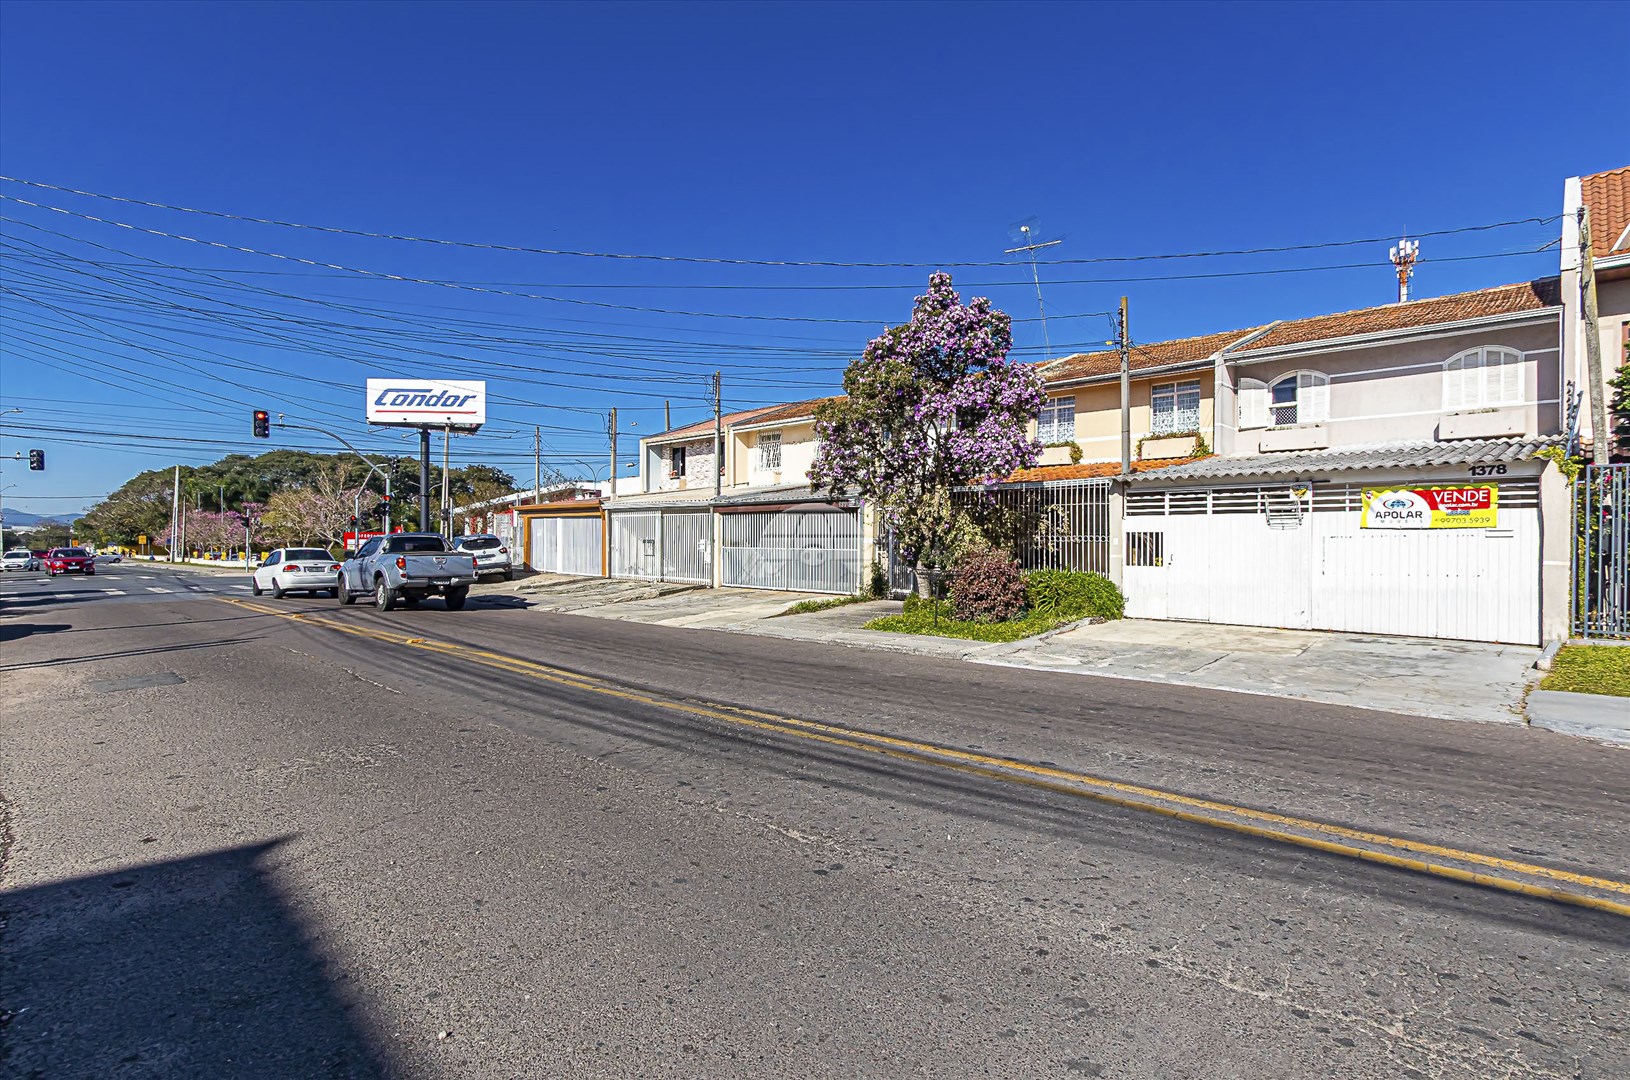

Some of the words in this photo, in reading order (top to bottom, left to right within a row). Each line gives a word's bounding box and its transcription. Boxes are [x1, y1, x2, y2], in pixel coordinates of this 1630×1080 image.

[374, 388, 477, 407] Condor
[1468, 463, 1507, 476] 1378
[1433, 490, 1488, 502] VENDE
[1375, 511, 1423, 519] APOLAR
